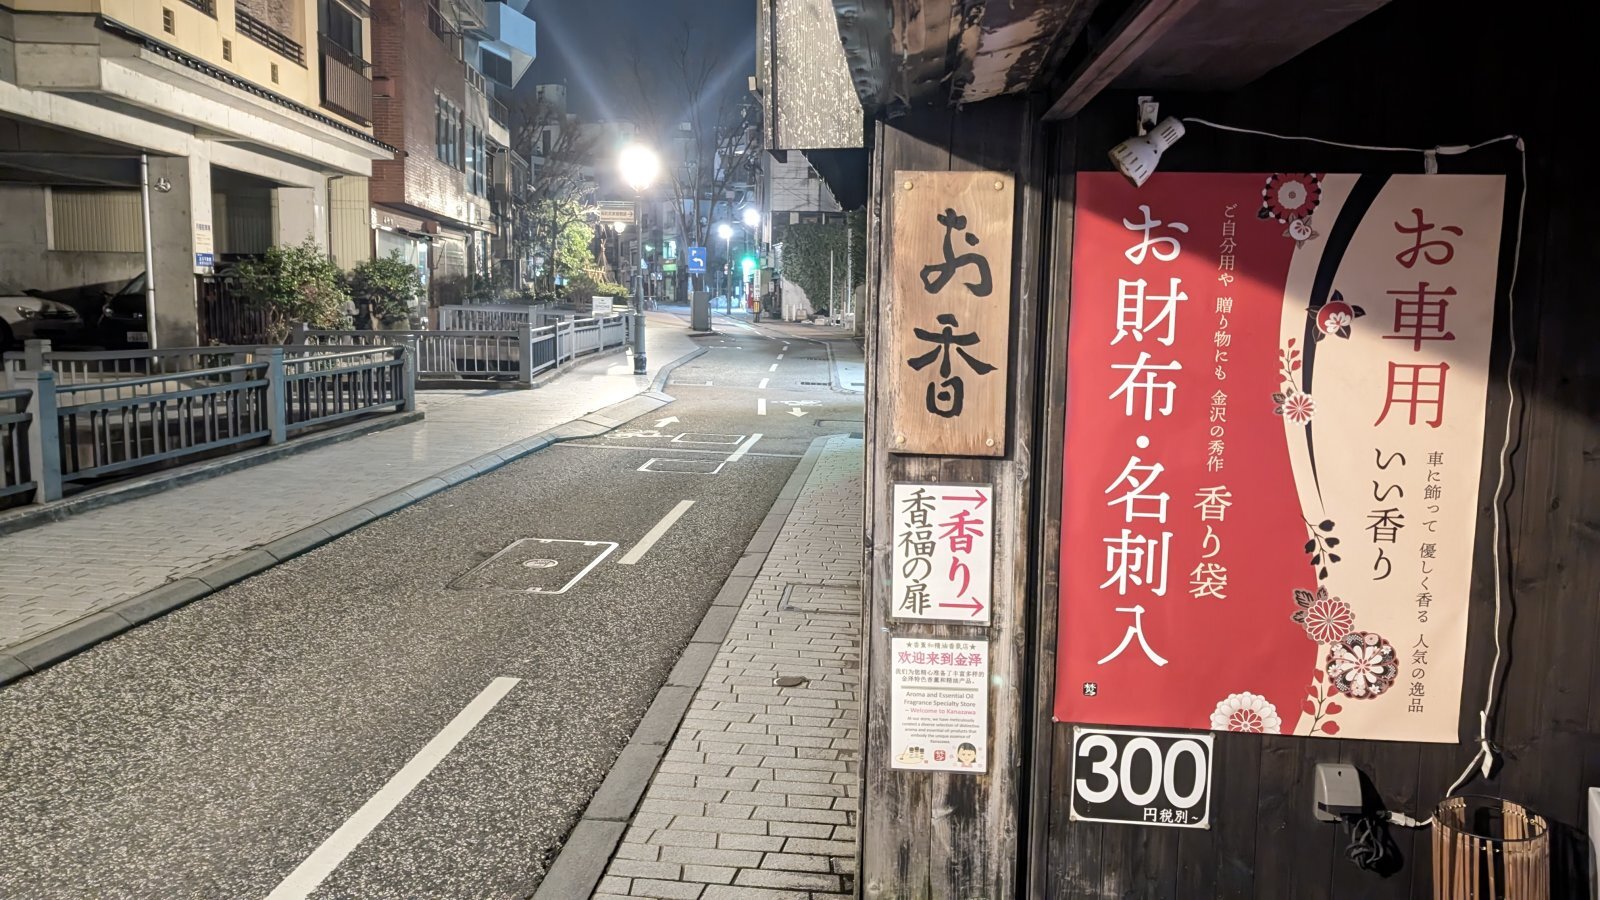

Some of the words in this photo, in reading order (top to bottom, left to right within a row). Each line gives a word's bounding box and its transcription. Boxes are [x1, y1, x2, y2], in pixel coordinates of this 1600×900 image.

[1218, 203, 1238, 287] ご自分用や
[907, 208, 998, 418] お香
[1213, 297, 1233, 380] 贈り物にも
[1374, 208, 1463, 428] お車用
[1097, 204, 1189, 667] お財布・名刺入
[1206, 389, 1228, 473] 金沢の秀作
[1365, 448, 1406, 581] いい香り
[1422, 451, 1444, 533] 車に飾って
[898, 488, 936, 615] 香福の扉
[938, 509, 984, 598] 香り
[1189, 485, 1232, 600] 香り袋
[1416, 542, 1437, 623] 優しく香る
[898, 651, 982, 667] 欢迎来到金泽
[1408, 634, 1430, 713] 人気の逸品
[1076, 734, 1207, 809] 300
